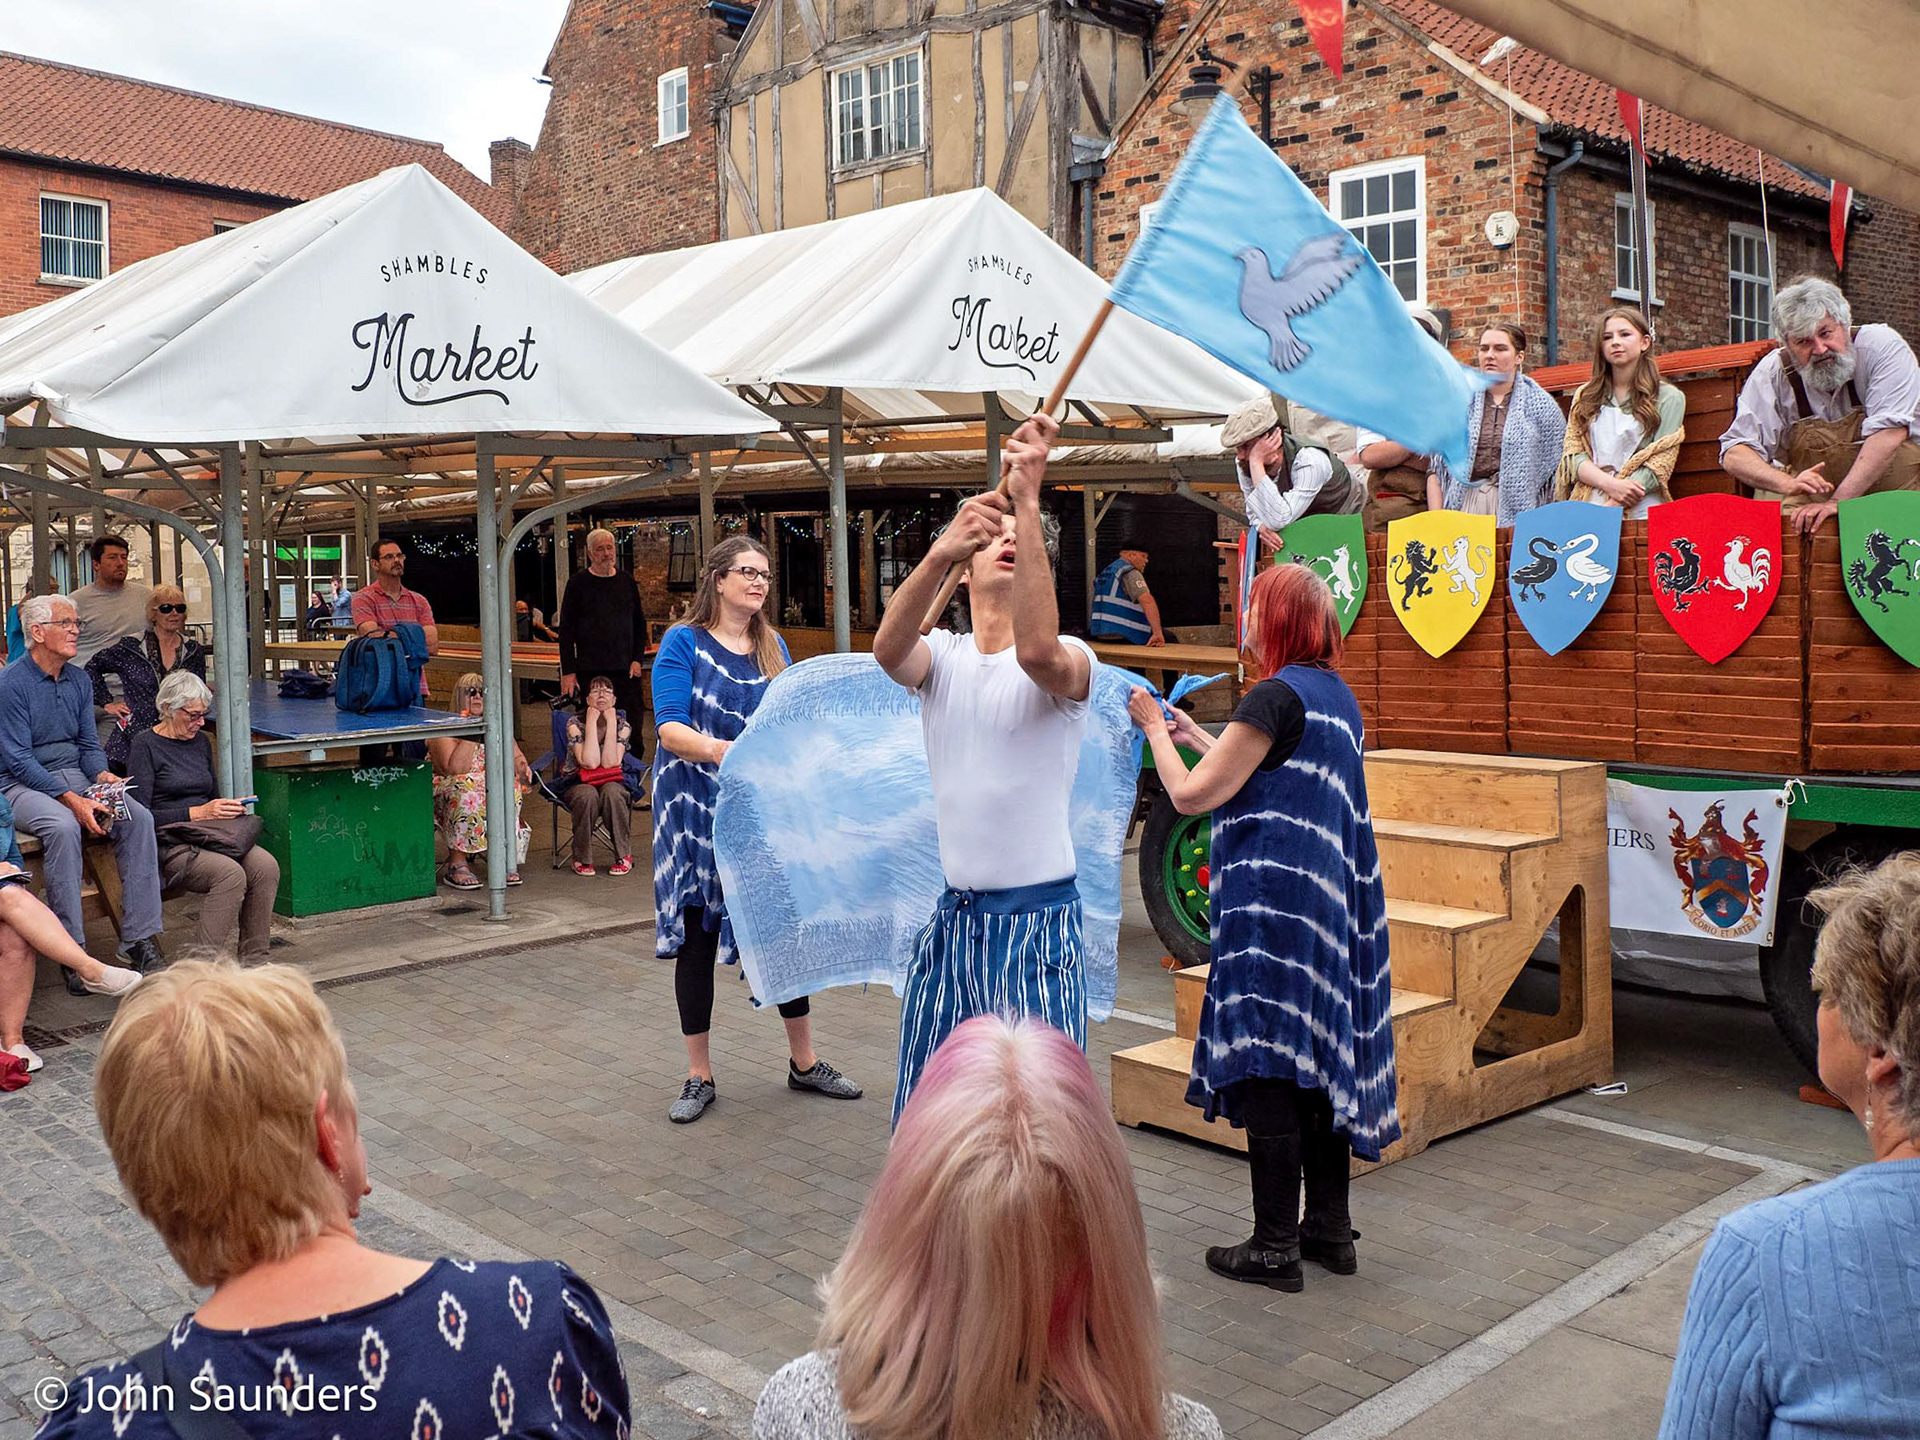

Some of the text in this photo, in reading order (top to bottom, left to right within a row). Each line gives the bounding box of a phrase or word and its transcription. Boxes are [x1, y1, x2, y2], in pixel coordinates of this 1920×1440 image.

[380, 255, 488, 284] SHAMBLES
[967, 254, 1033, 286] SHAMBLES
[351, 312, 539, 406] Market
[1607, 827, 1656, 851] ERS
[1693, 917, 1717, 935] CORIO
[1733, 923, 1752, 937] ARTE
